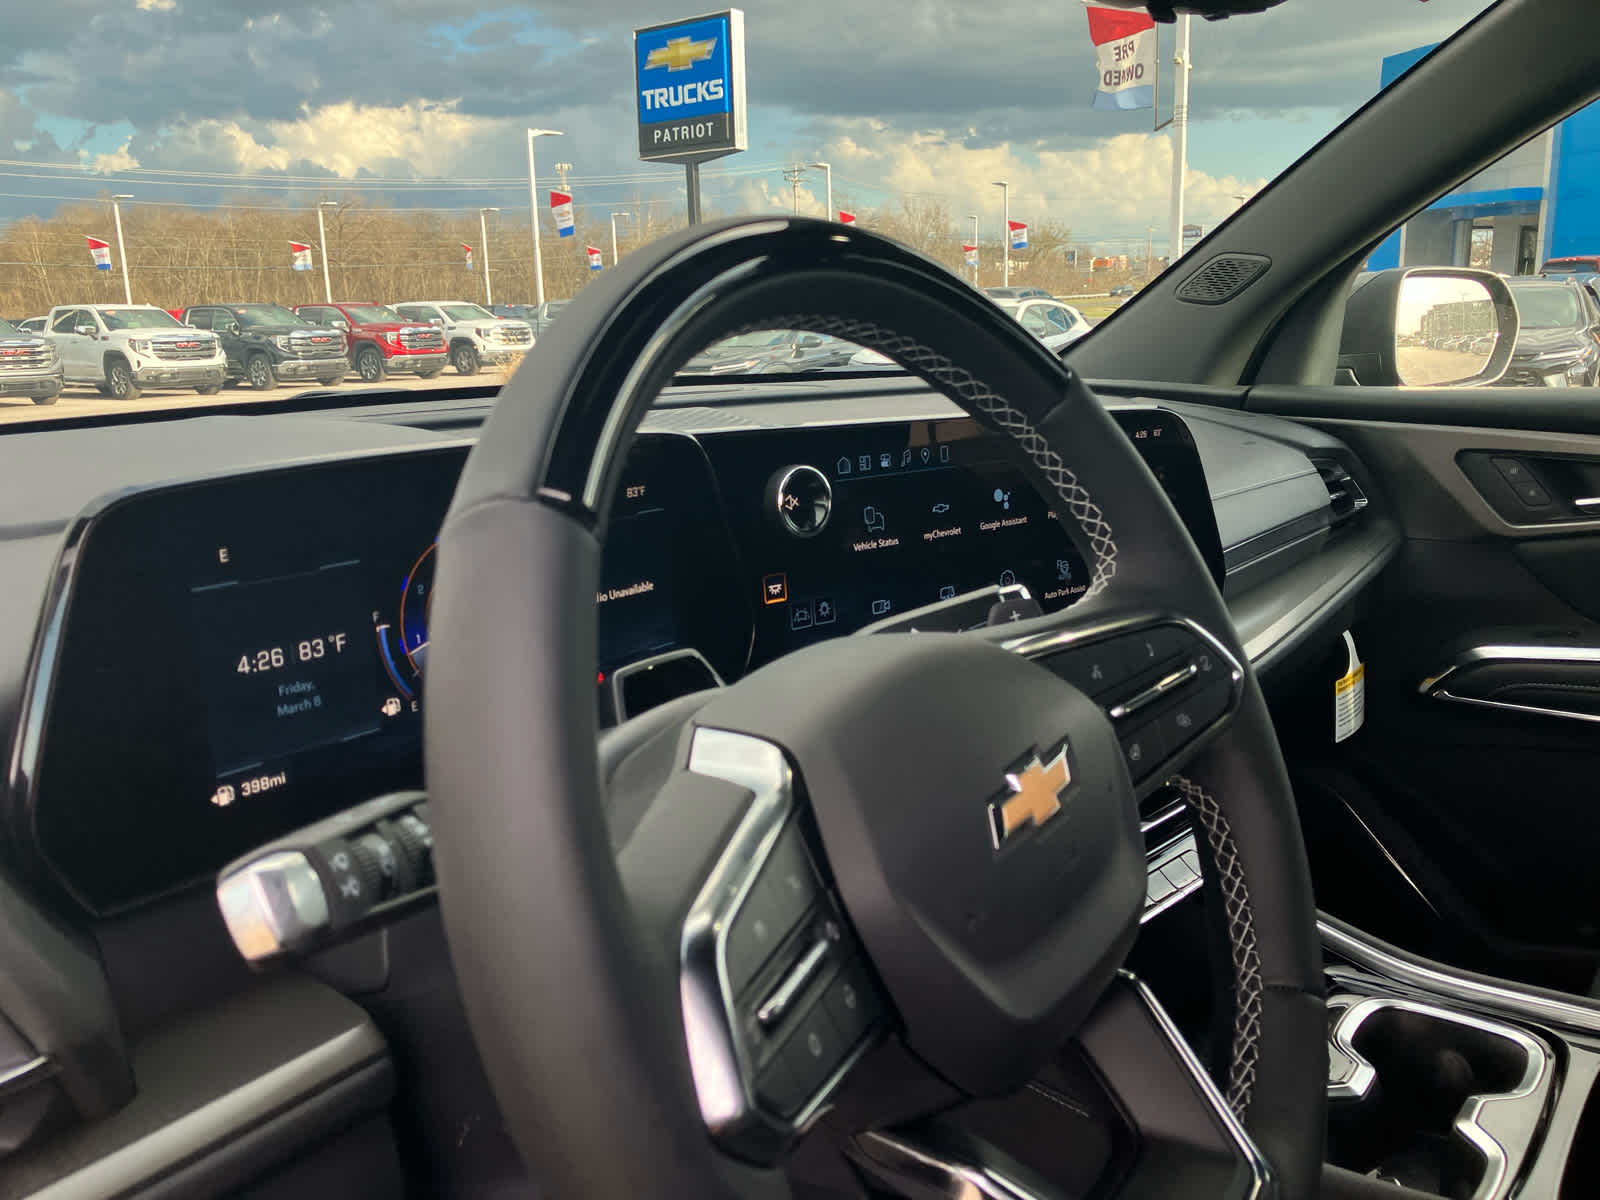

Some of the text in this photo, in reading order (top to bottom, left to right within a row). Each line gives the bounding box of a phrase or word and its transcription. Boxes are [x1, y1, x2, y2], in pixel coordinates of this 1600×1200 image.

[642, 78, 724, 110] TRUCKS
[653, 122, 714, 144] PATRIOT
[980, 516, 1028, 531] Google Assistant
[923, 527, 962, 541] myChevrolet
[852, 538, 900, 552] Vehicle Status
[218, 548, 229, 563] E
[608, 580, 655, 600] Unavailable
[237, 647, 285, 675] 4:26
[276, 698, 313, 718] March
[240, 771, 287, 797] 398mi
